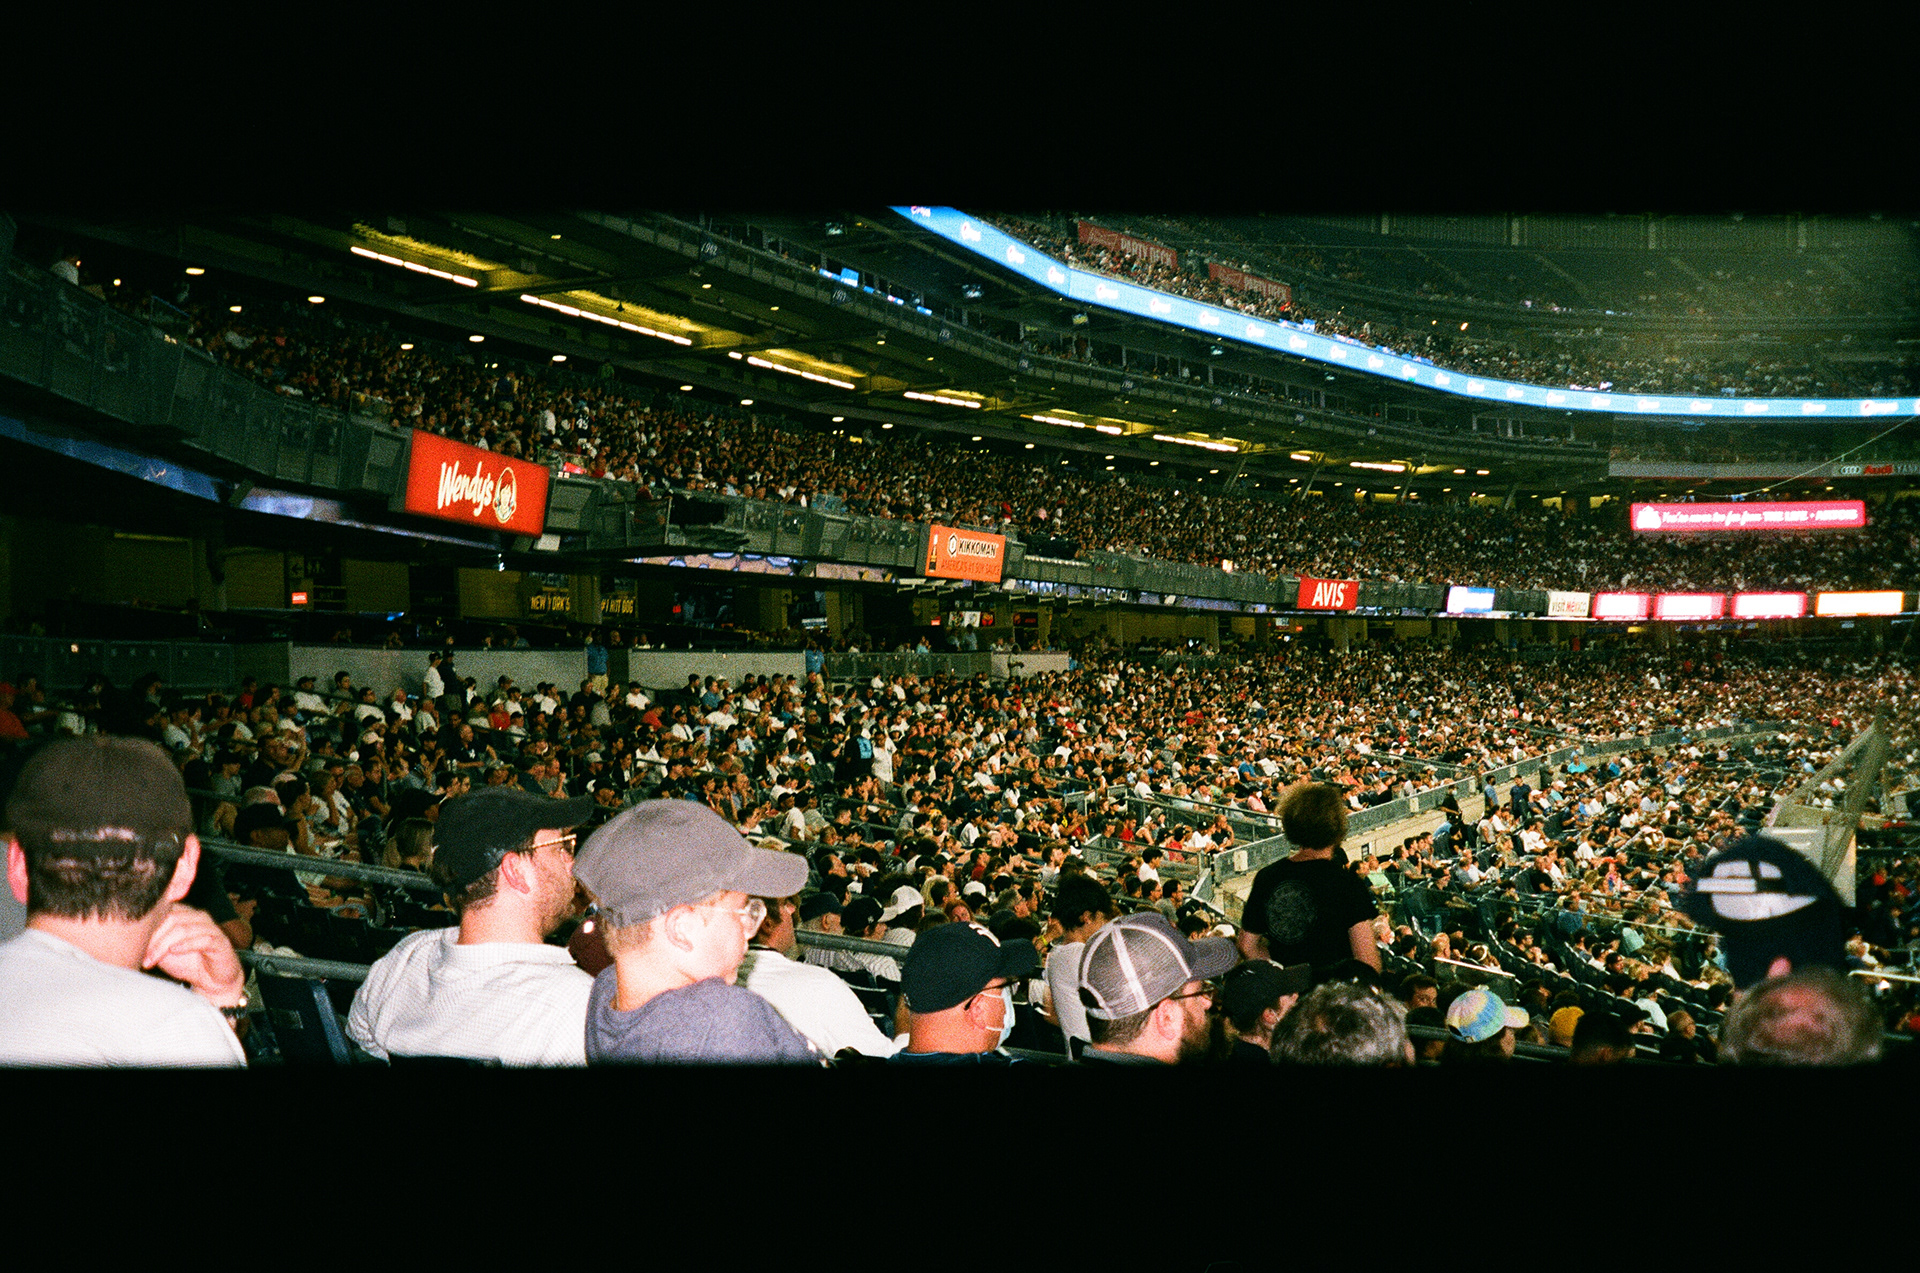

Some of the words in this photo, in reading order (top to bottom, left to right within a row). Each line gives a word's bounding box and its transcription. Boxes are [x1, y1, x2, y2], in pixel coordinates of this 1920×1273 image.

[1864, 464, 1895, 474] Audi
[437, 460, 494, 517] Wendy's
[959, 540, 996, 557] KIKKOMAN
[1312, 582, 1345, 608] AVIS
